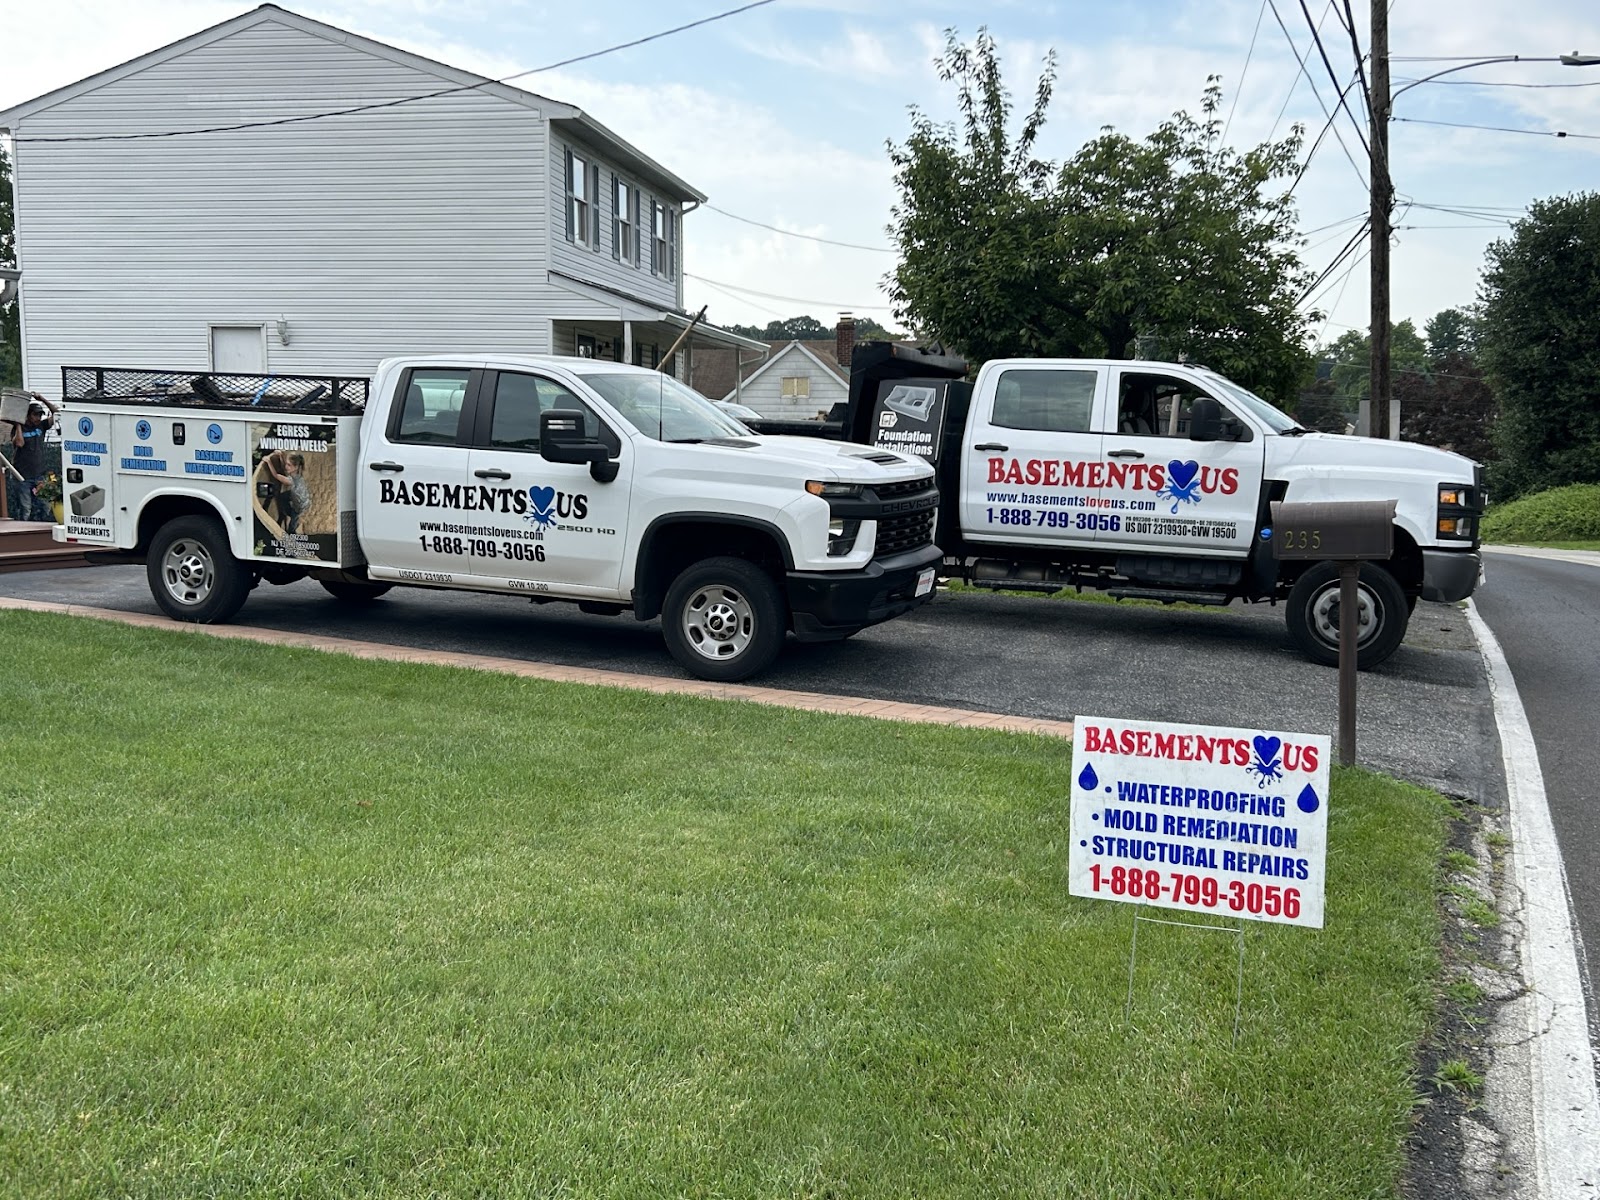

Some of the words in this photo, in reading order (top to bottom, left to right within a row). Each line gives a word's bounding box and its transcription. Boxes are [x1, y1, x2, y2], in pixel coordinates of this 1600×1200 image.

[277, 425, 310, 438] EGRESS
[878, 429, 932, 442] Foundation
[64, 440, 108, 454] STRUCTURAL
[133, 446, 153, 457] MOLD
[260, 438, 298, 451] WINDOW
[300, 439, 328, 452] WELLS
[72, 454, 100, 466] REPAIRS
[194, 450, 233, 462] BASEMENT
[120, 458, 166, 471] REMEDIATION
[184, 462, 244, 477] WATERPROOFING
[987, 457, 1165, 491] BASEMENTS
[1201, 466, 1239, 495] US
[380, 479, 527, 514] BASEMENTS
[556, 492, 588, 520] US
[987, 492, 1155, 511] www.basementsloveus.com
[71, 515, 105, 525] FOUNDATION
[986, 507, 1121, 532] 1-888-799-3056
[67, 526, 110, 537] REPLACEMENTS
[420, 522, 544, 540] www.basementsloveus.com
[557, 524, 593, 533] 2500
[1126, 522, 1135, 533] US
[1137, 523, 1151, 534] DOT
[1153, 524, 1187, 536] 2319930
[1192, 526, 1210, 537] GVW
[1212, 527, 1236, 539] 19500
[1285, 531, 1321, 549] 235
[419, 535, 546, 562] 1-888-799-3056
[399, 570, 422, 579] USDOT
[424, 572, 452, 582] 2319930
[1084, 726, 1250, 766] BASEMENTS
[1282, 742, 1318, 773] US
[1117, 781, 1286, 818] WATERPROOFING
[1104, 808, 1157, 833] MOLD
[1163, 815, 1298, 849] REMEDIATION
[1092, 835, 1218, 869] STRUCTURAL
[1223, 850, 1309, 880] REPAIRS
[1089, 864, 1300, 919] 1-888-799-3056
